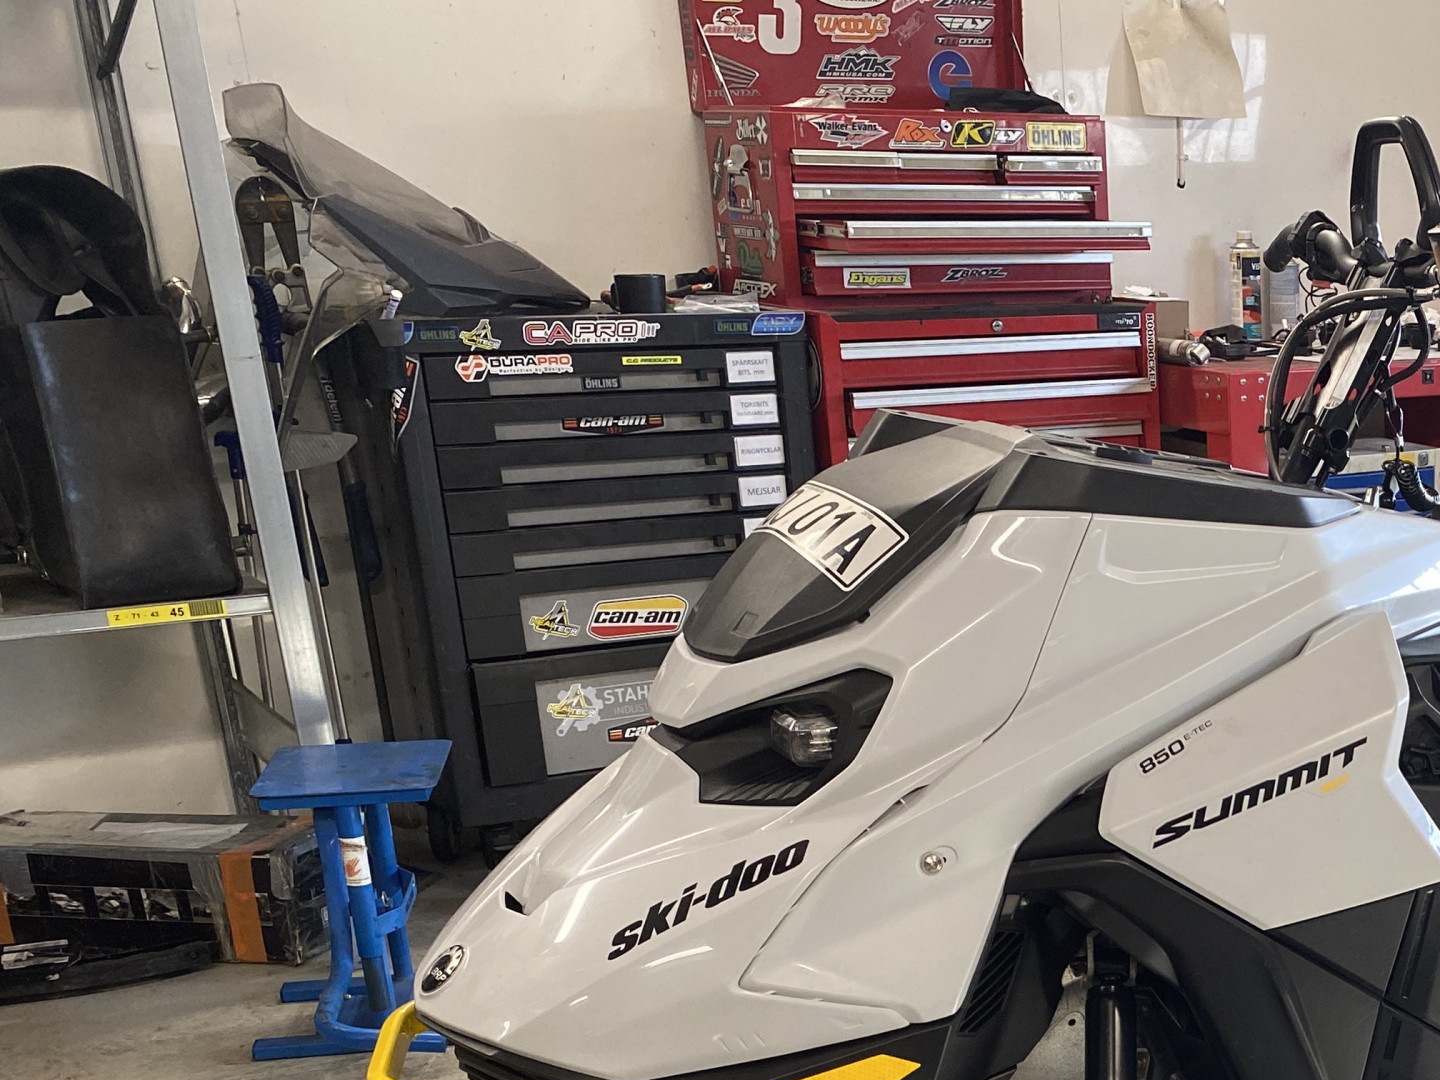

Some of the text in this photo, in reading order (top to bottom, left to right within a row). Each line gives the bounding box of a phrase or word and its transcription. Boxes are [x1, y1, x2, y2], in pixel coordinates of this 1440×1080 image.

[936, 16, 992, 31] FLY
[822, 56, 894, 71] HMK
[707, 89, 762, 97] HONDA
[818, 121, 877, 131] Walker Evans
[1030, 125, 1081, 147] ÖHLINS
[848, 272, 907, 286] Engans
[760, 316, 797, 326] TIDY
[574, 321, 639, 338] PRO
[1146, 314, 1157, 388] BOONDOCKER
[489, 355, 571, 368] DURAPRO
[585, 377, 619, 389] ÖHLINS
[579, 415, 647, 428] can-am
[740, 446, 782, 455] RINGNYCKLAR
[747, 487, 782, 496] MEJSLAR
[169, 607, 185, 617] 45
[593, 610, 682, 625] can-am
[1138, 719, 1214, 775] 850 E-TEC
[1151, 736, 1369, 850] SUMMIT
[607, 839, 810, 961] ski-doo
